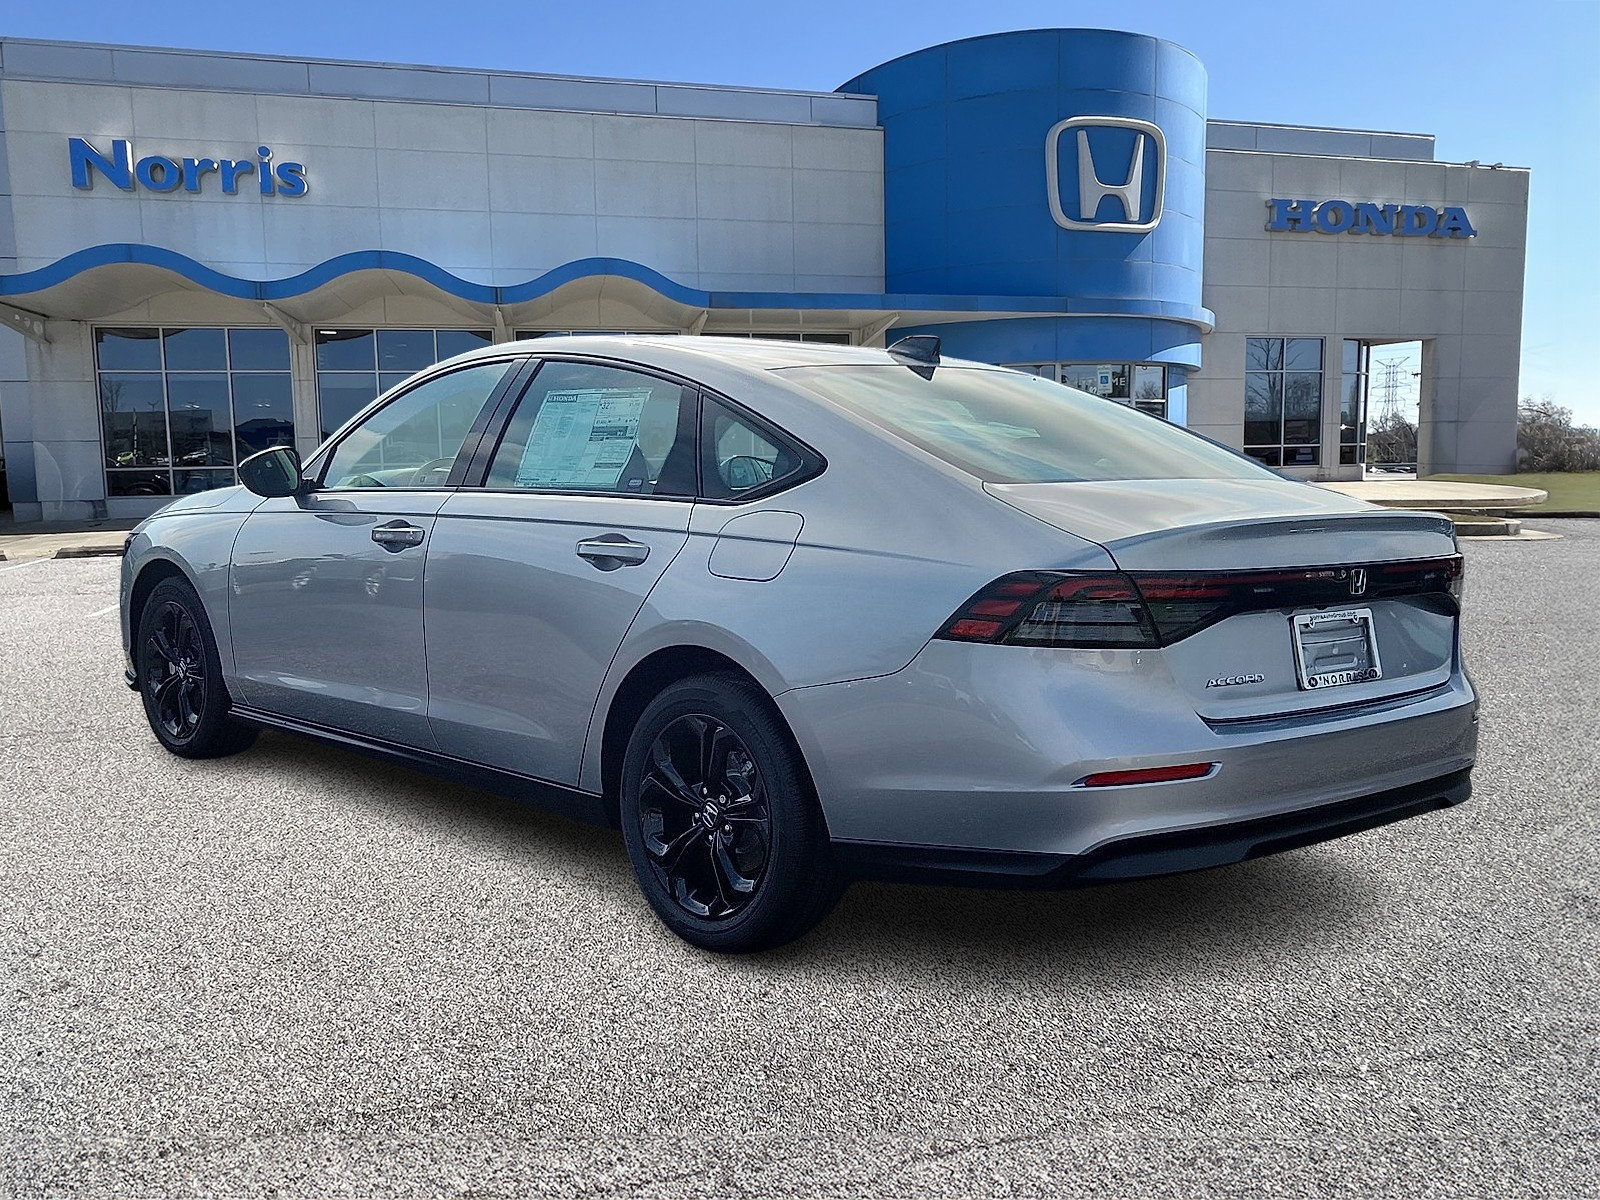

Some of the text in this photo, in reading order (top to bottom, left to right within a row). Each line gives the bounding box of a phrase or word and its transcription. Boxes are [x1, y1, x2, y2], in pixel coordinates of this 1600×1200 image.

[68, 137, 309, 198] Norris
[1265, 197, 1477, 238] HONDA
[1205, 674, 1265, 689] ACCORD
